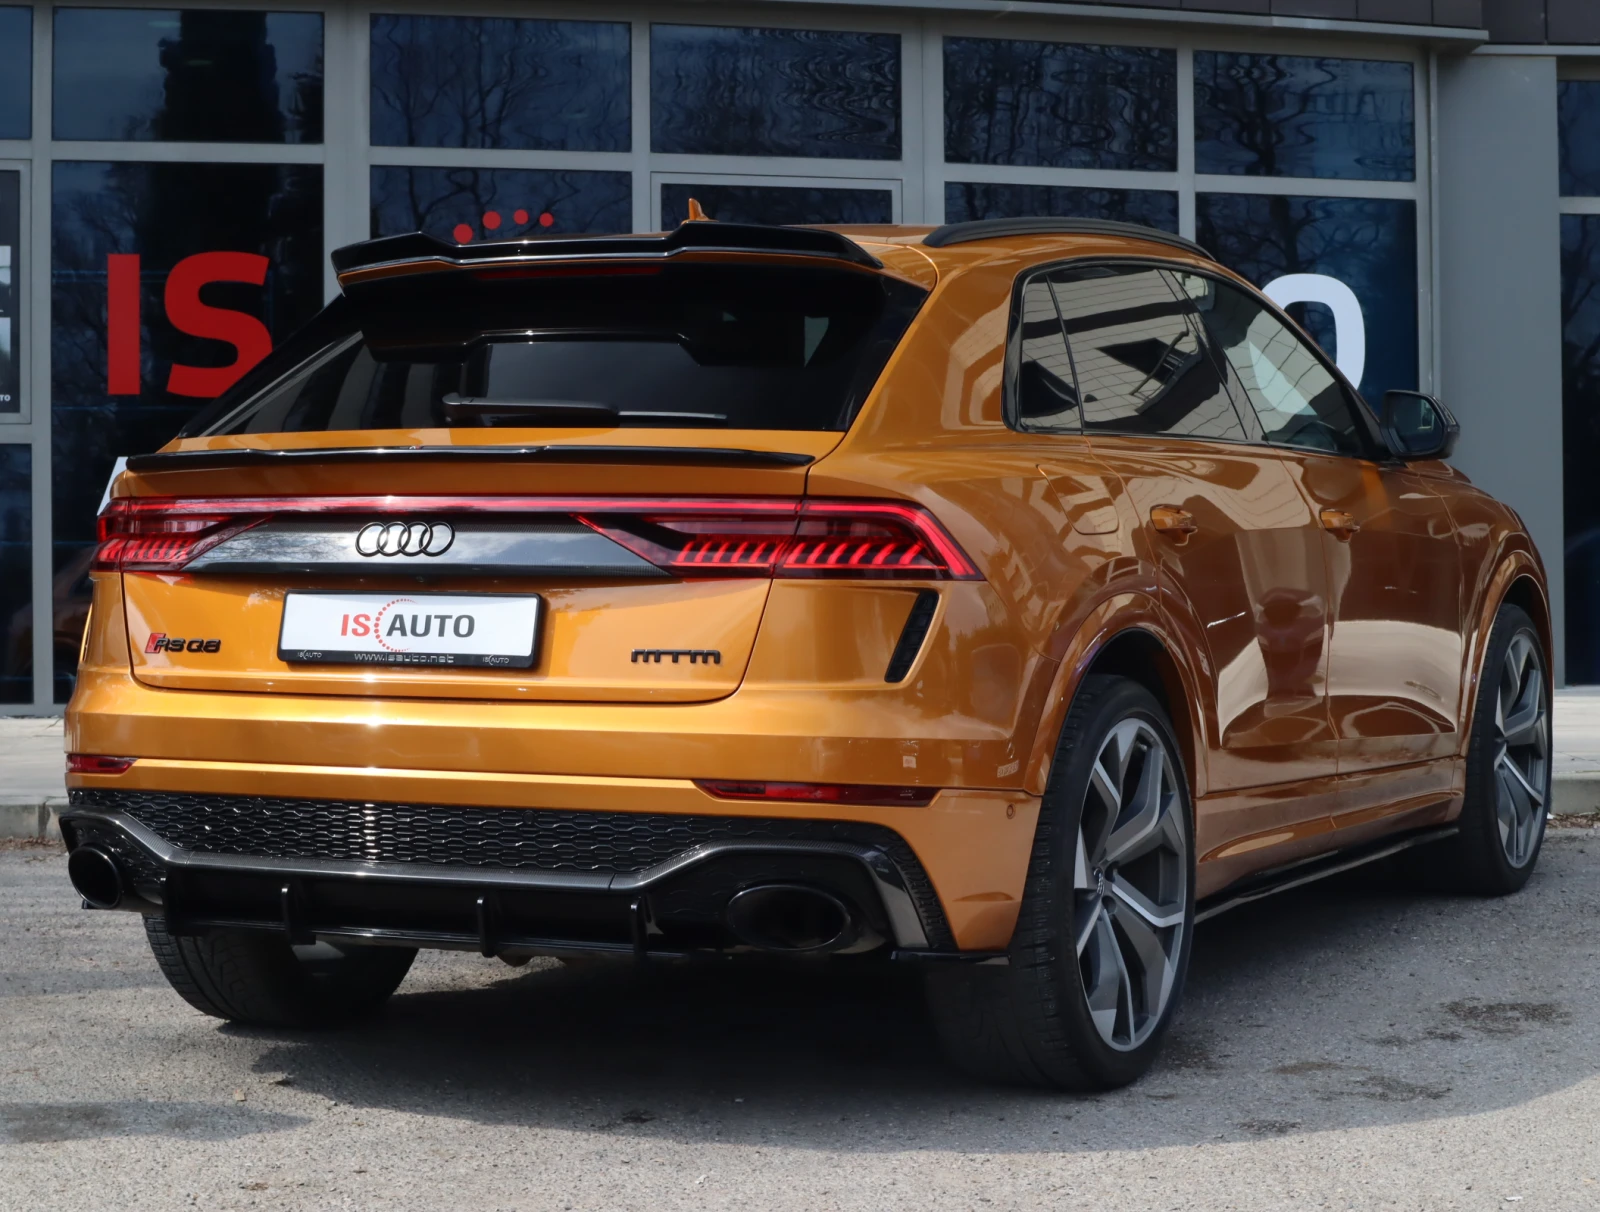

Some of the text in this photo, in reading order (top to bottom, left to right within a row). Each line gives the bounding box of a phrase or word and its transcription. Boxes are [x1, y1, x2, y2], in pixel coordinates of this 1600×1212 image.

[107, 251, 272, 398] IS
[340, 613, 475, 638] IS AUTO
[153, 637, 222, 653] RS Q8
[354, 653, 455, 663] www.isauto.net
